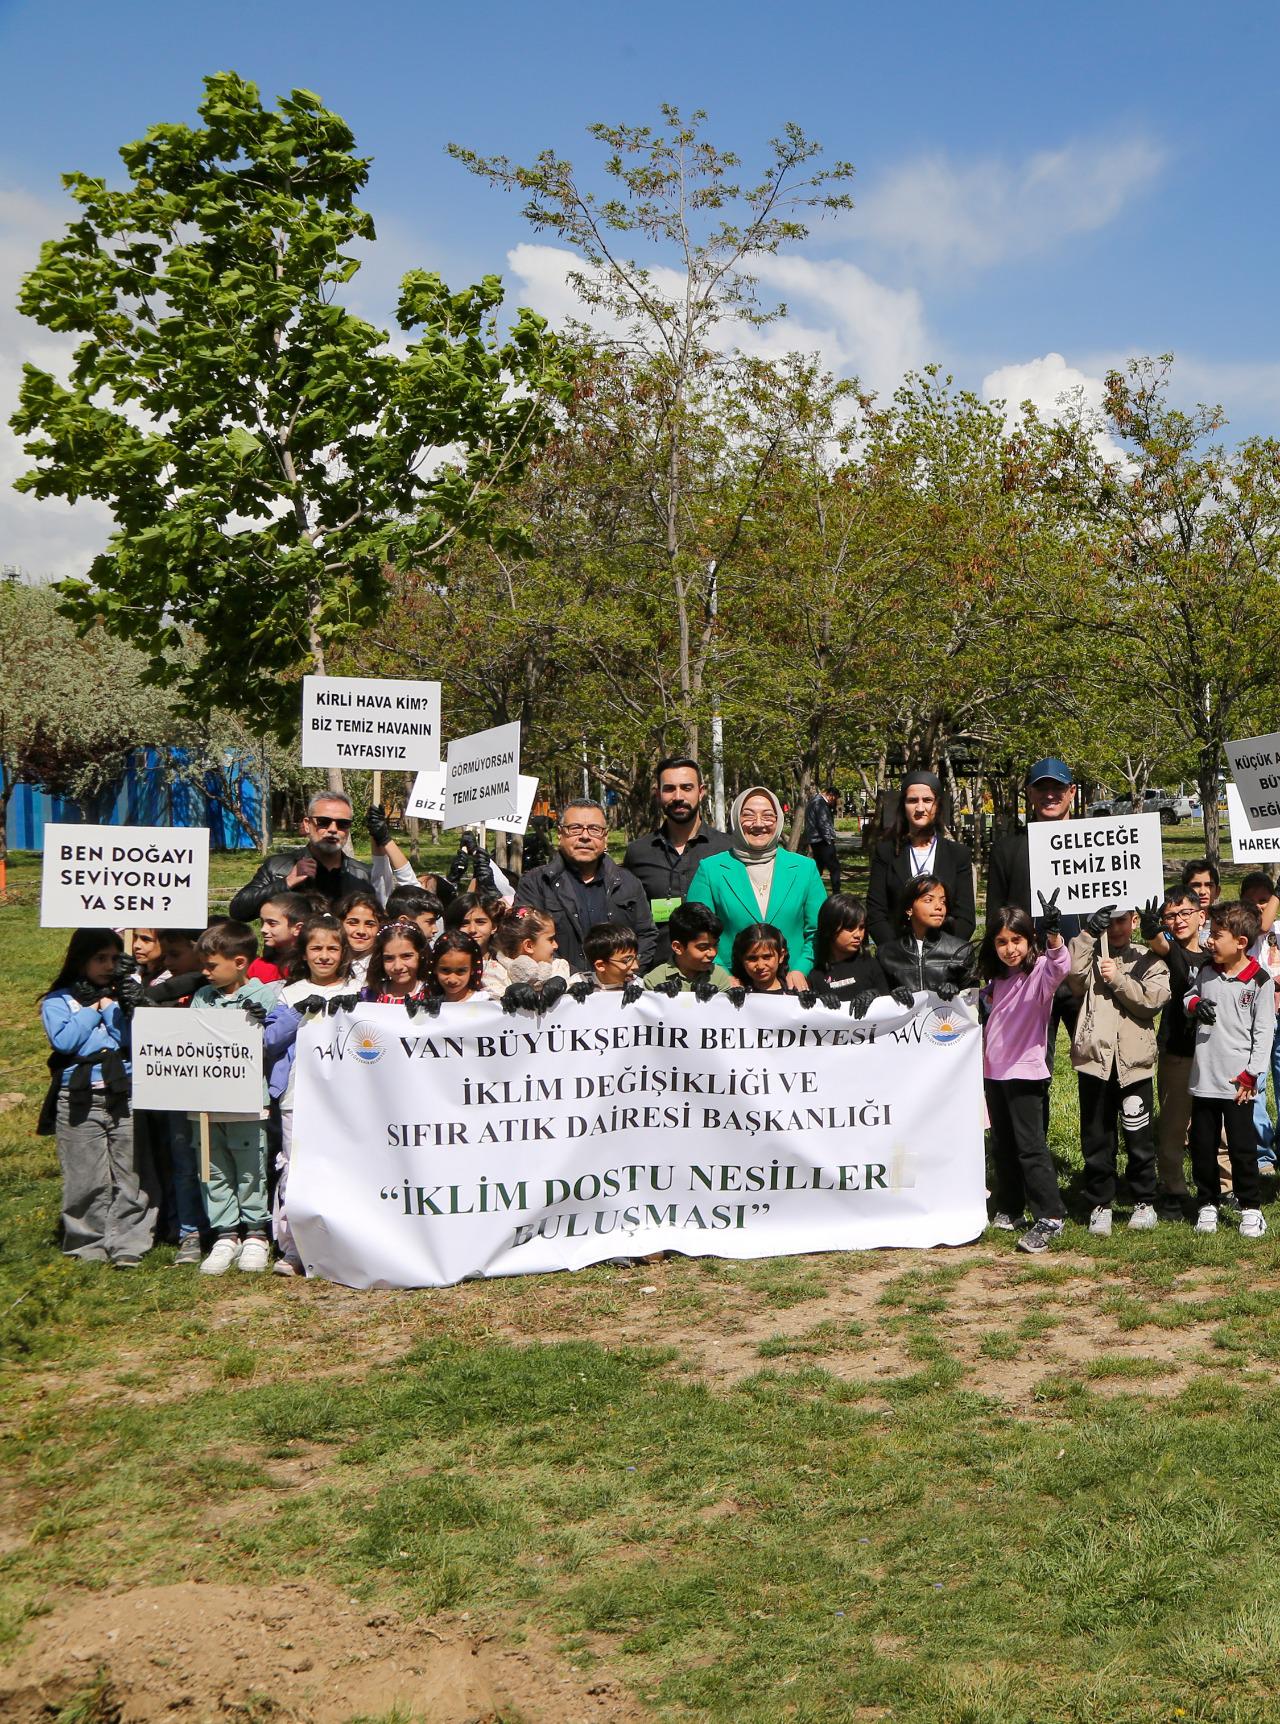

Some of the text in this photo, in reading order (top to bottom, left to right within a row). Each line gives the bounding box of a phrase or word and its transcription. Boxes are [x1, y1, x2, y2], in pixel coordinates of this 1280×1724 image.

[316, 690, 428, 711] KİRLİ HAVA KİM?
[311, 716, 432, 736] BİZ TEMİZ HAVANIN
[336, 743, 407, 759] TAYFASIYIZ
[1235, 752, 1273, 770] KÜÇÜK
[451, 751, 514, 778] GÖRMÜYORSAN
[453, 786, 478, 805] TEMİZ
[479, 781, 510, 799] SANMA
[415, 798, 437, 810] BİZ
[1050, 825, 1139, 850] GELECEĞE
[60, 844, 193, 864] BEN DOĞAYI
[1051, 850, 1141, 876] TEMİZ BİR
[60, 867, 191, 888] SEVİYORUM
[1067, 880, 1128, 900] NEFES!
[80, 894, 106, 910] YA
[113, 895, 154, 911] SEN
[400, 1036, 464, 1059] VAN
[476, 1021, 689, 1058] BÜYÜKŞEHİR
[699, 1024, 878, 1050] BELEDİYESİ
[139, 1042, 253, 1062] ATMA DÖNÜŞTÜR,
[146, 1060, 246, 1079] DÜNYAYI KORU!
[461, 1064, 819, 1106] İKLİM DEĞİŞİKLİĞİ VE
[387, 1098, 893, 1147] SIFIR ATIK DAİRESİ BAŞKANLIĞI
[380, 1159, 889, 1216] “İKLİM DOSTU NESİLLER
